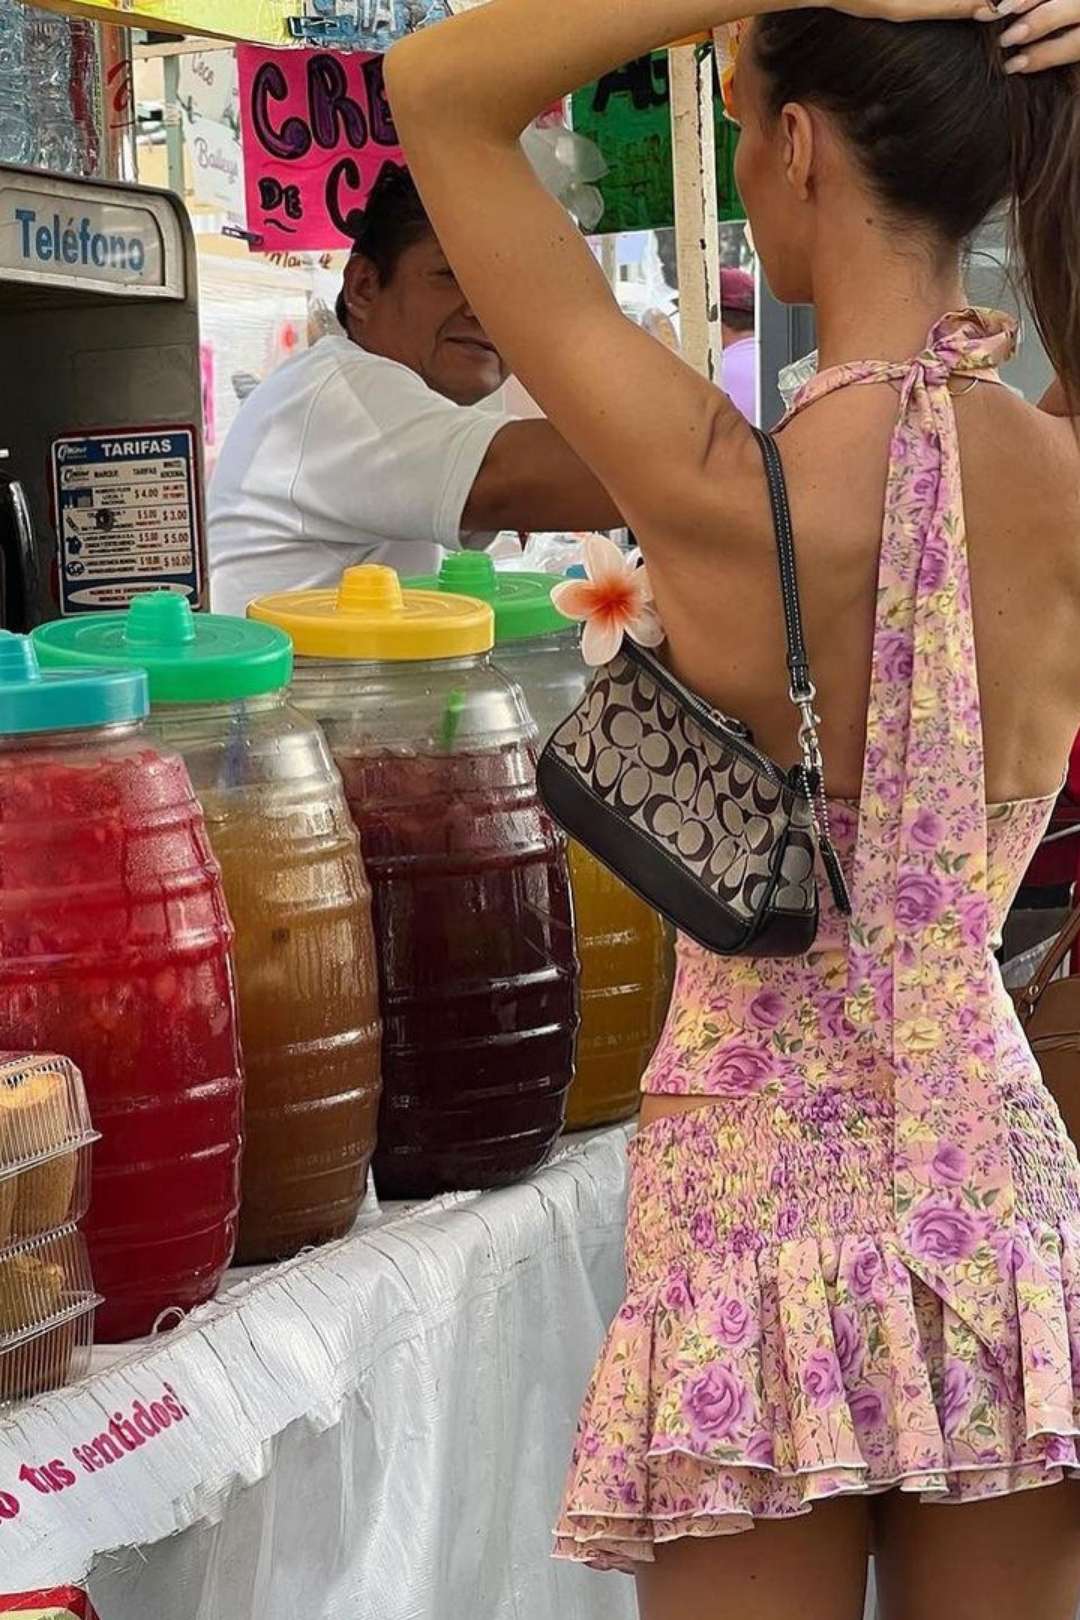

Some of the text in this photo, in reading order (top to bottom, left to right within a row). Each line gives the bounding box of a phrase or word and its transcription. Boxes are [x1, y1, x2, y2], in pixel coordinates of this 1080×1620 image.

[252, 54, 399, 160] CRE
[258, 176, 303, 219] DE
[15, 208, 145, 271] Teléfono
[101, 439, 172, 457] TARIFAS
[141, 488, 159, 498] 4.00
[171, 532, 189, 543] 5.00
[19, 1459, 76, 1493] tus
